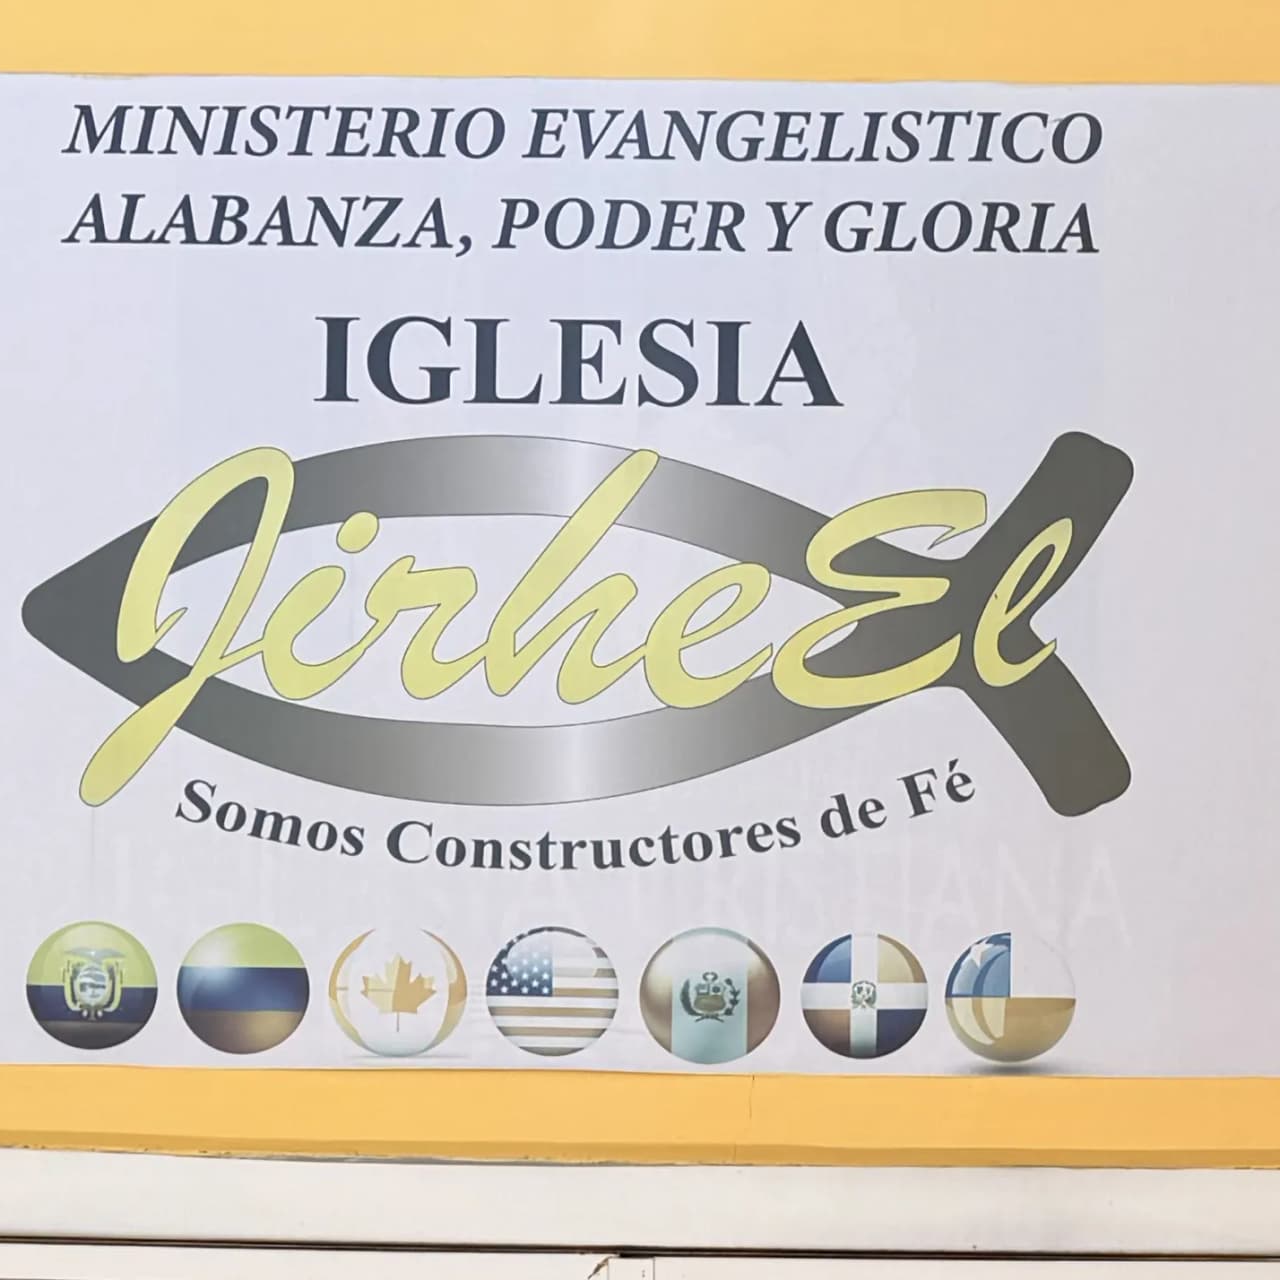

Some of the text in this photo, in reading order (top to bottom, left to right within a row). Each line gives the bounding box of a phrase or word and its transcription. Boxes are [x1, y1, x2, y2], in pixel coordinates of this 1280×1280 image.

[61, 104, 1103, 165] MINISTERIO EVANGELISTICO
[60, 193, 1100, 258] ALABANZA, PODER Y GLORIA
[313, 316, 844, 408] IGLESIA
[175, 758, 975, 871] Somos Constructores de Fé
